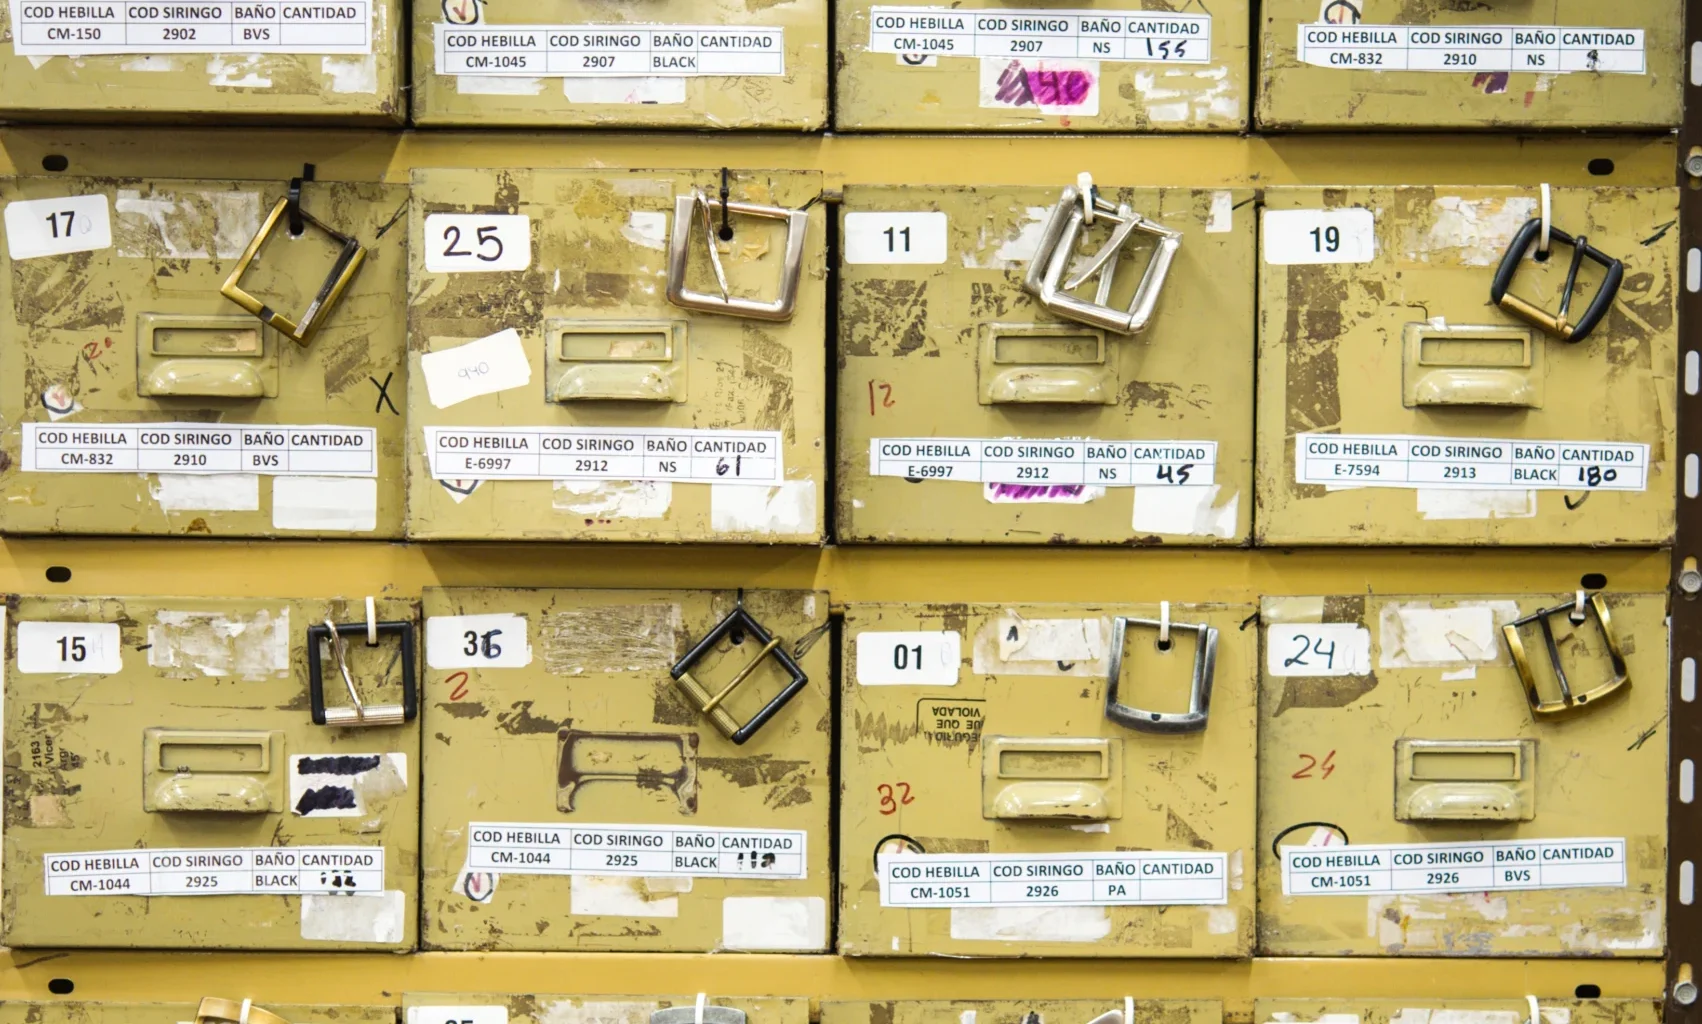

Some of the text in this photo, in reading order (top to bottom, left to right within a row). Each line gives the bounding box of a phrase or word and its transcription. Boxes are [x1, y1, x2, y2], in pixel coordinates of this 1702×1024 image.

[24, 4, 356, 18] COD HEBILLA COD SIRINGO BAÑO CANTIDAD
[48, 28, 269, 40] CM-150 2902 BVS
[876, 17, 1199, 34] COD HEBILLA COD SIRINGO BAÑO CANTIDAD
[448, 33, 772, 48] COD HEBILLA COD SIRINGO BAÑO CANTIDAD
[894, 38, 1110, 53] CM-1045 2907 NS
[1308, 31, 1635, 45] COD HEBILLA COD SIRINGO BAÑO CANTIDAD
[466, 56, 695, 68] CM-1045 2907 BLACK
[1330, 52, 1545, 66] CM-832 2910 NS
[46, 210, 75, 238] 17
[443, 226, 503, 261] 25
[883, 227, 910, 252] 11
[1310, 226, 1339, 252] 19
[39, 432, 363, 446] COD HEBILLA COD SIRINGO BAÑO CANTIDAD
[440, 437, 766, 453] COD HEBILLA COD SIRINGO BAÑO CANTIDAD
[61, 453, 279, 466] CM-832 2910 BVS
[882, 445, 1205, 460] COD HEBILLA COD SIRINGO BAÑO CANTIDAD
[1309, 443, 1634, 461] COD HEBILLA COD SIRINGO BAÑO CANTIDAD
[465, 458, 676, 472] E-6997 2912 NS
[908, 466, 1116, 479] E-6997 2912 NS
[1335, 464, 1557, 481] E-7594 2913 BLACK
[1157, 464, 1193, 484] 45
[1578, 466, 1617, 486] 180
[57, 637, 86, 662] 15
[894, 644, 922, 670] 01
[1284, 635, 1335, 669] 24
[445, 671, 468, 701] 2
[932, 707, 980, 717] VIOLADA
[936, 719, 960, 729] QUE
[877, 782, 915, 815] 32
[473, 831, 792, 849] COD HEBILLA COD SIRINGO BAÑO CANTIDAD
[51, 852, 373, 872] COD HEBILLA COD SIRINGO BAÑO CANTIDAD
[491, 852, 717, 868] CM-1044 2925 BLACK
[1292, 847, 1614, 868] COD HEBILLA COD SIRINGO BAÑO CANTIDAD
[892, 861, 1214, 879] COD HEBILLA COD SIRINGO BAÑO CANTIDAD
[71, 875, 297, 891] CM-1044 2925 BLACK
[1312, 870, 1530, 888] CM-1051 2926 BVS
[911, 885, 1126, 898] CM-1051 2926 PA
